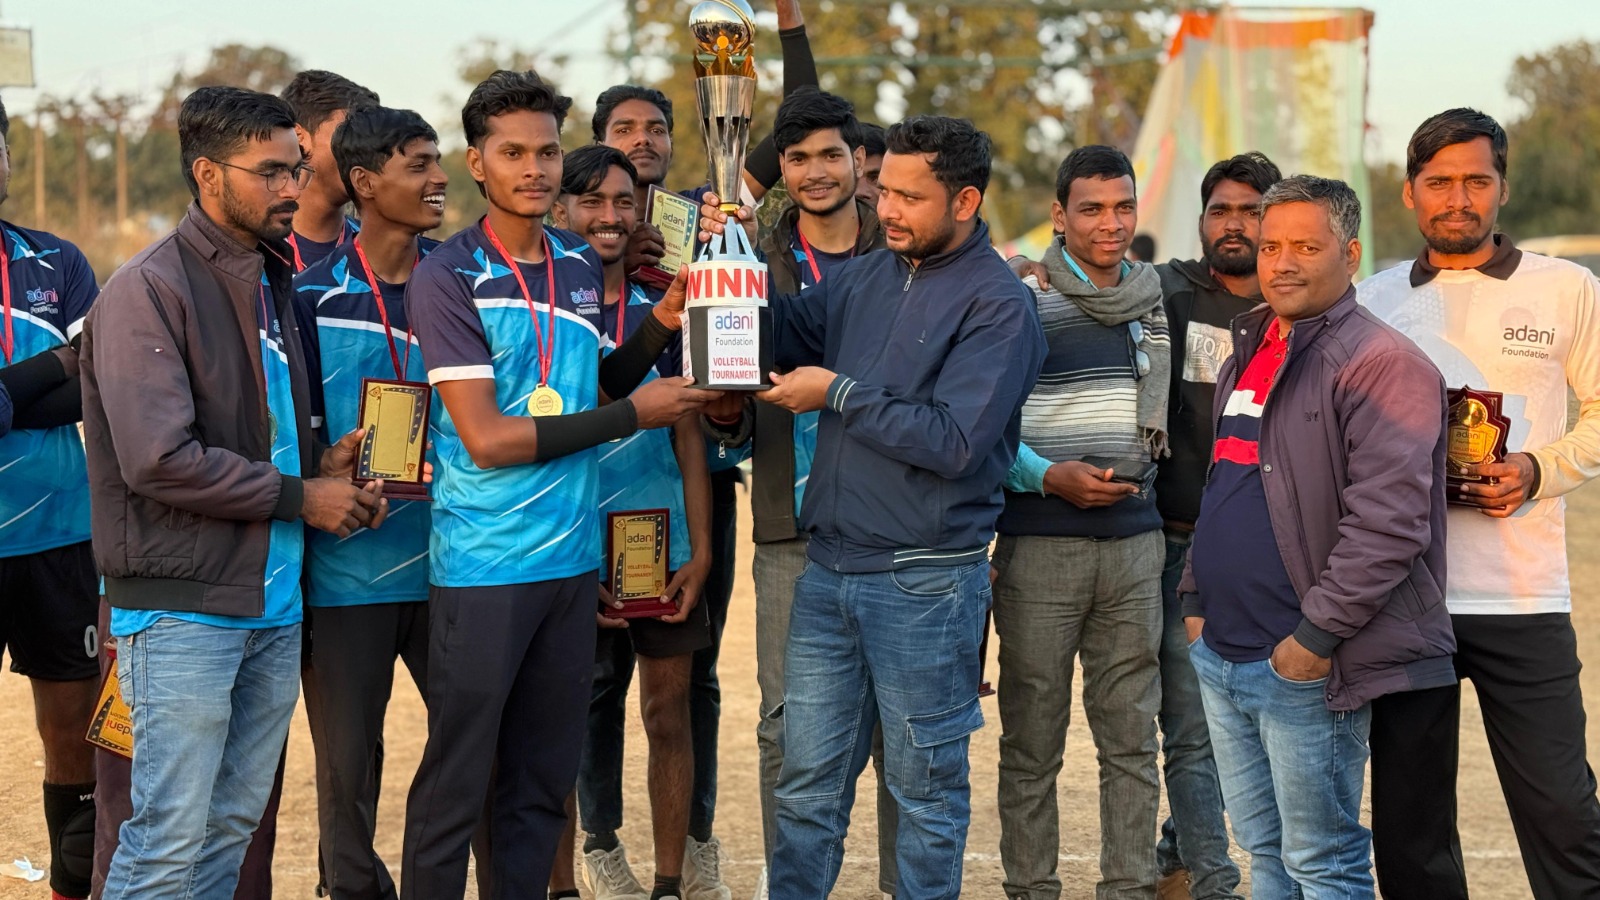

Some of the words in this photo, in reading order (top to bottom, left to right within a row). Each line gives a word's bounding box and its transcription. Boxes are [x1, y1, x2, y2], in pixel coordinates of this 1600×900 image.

[662, 212, 686, 228] adani
[715, 311, 753, 330] adani
[1503, 324, 1556, 346] adani
[715, 337, 754, 346] Foundation
[1501, 347, 1549, 360] Foundation
[713, 357, 756, 366] VOLLEYBALL
[712, 370, 758, 380] TOURNAMENT
[627, 533, 654, 543] adani
